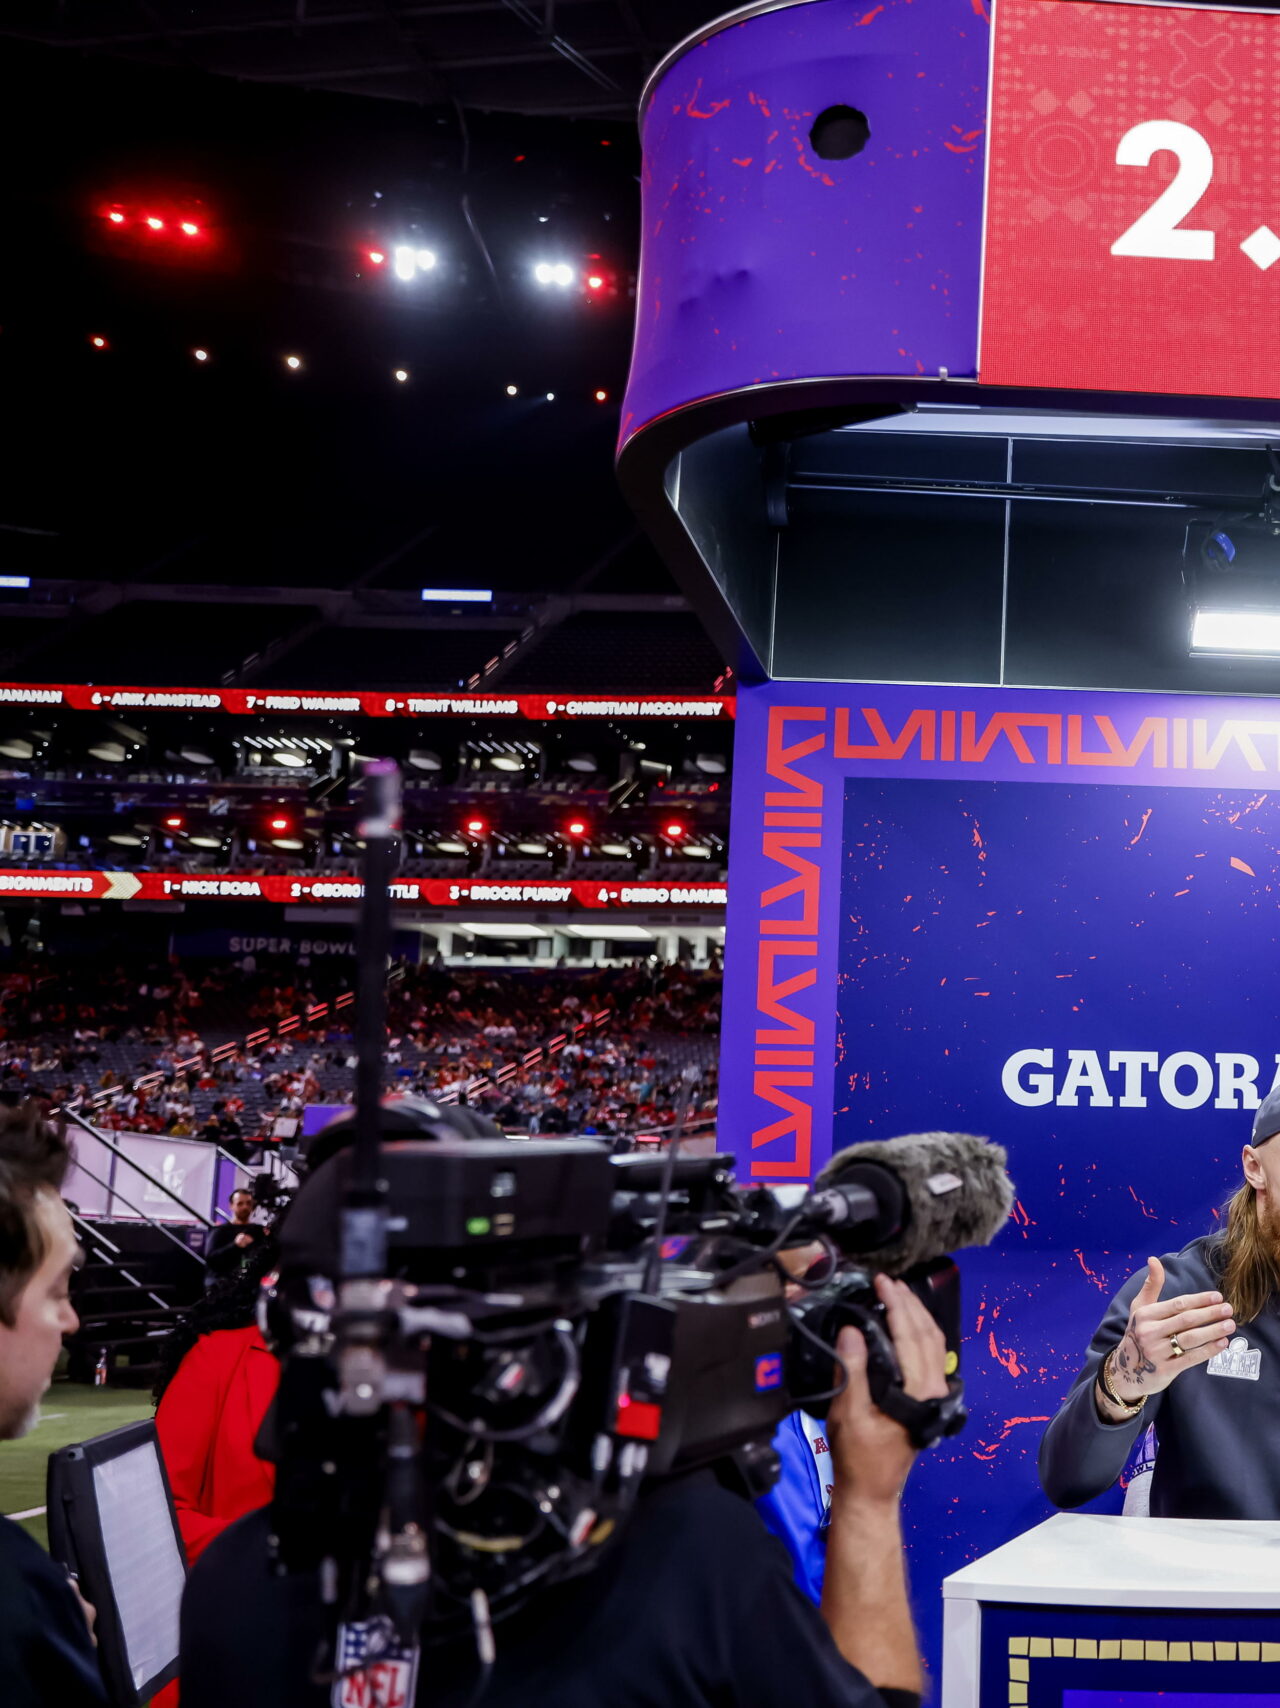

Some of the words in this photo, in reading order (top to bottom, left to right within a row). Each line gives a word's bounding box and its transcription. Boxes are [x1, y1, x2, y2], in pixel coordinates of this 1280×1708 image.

[302, 697, 360, 711] WARNER
[451, 700, 518, 713] WILLIAMS
[566, 701, 638, 715] CHRISTIAN
[182, 881, 219, 894] NICK
[220, 881, 261, 895] BOSA
[450, 886, 459, 899] 3
[523, 887, 571, 901] PURDY
